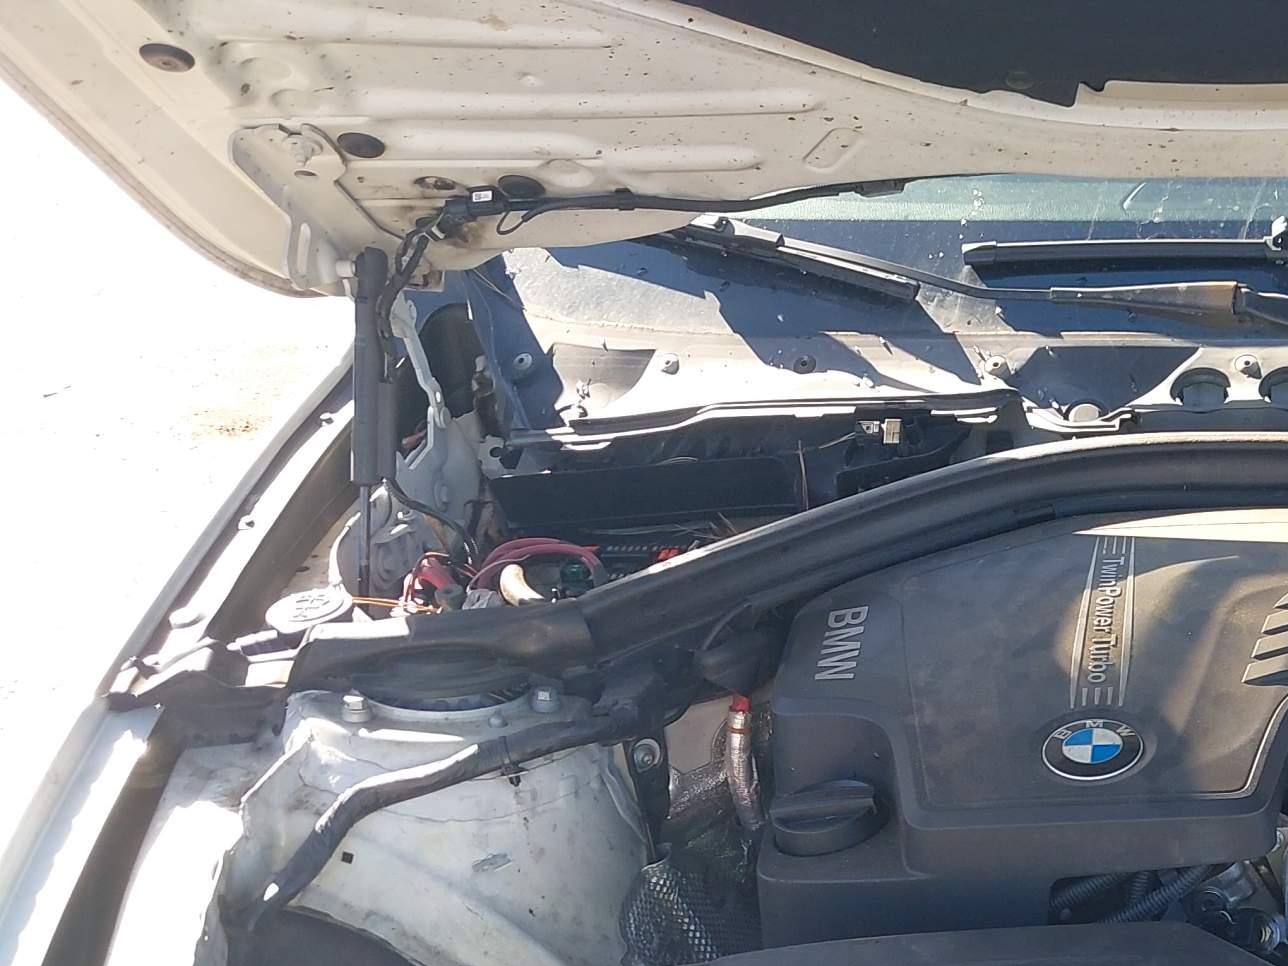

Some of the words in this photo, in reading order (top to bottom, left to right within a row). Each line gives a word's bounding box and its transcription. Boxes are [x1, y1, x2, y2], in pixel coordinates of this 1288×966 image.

[1093, 556, 1125, 634] TwinPower
[814, 605, 869, 680] BMW
[1087, 632, 1119, 684] Turbo
[1053, 719, 1137, 740] BMW
